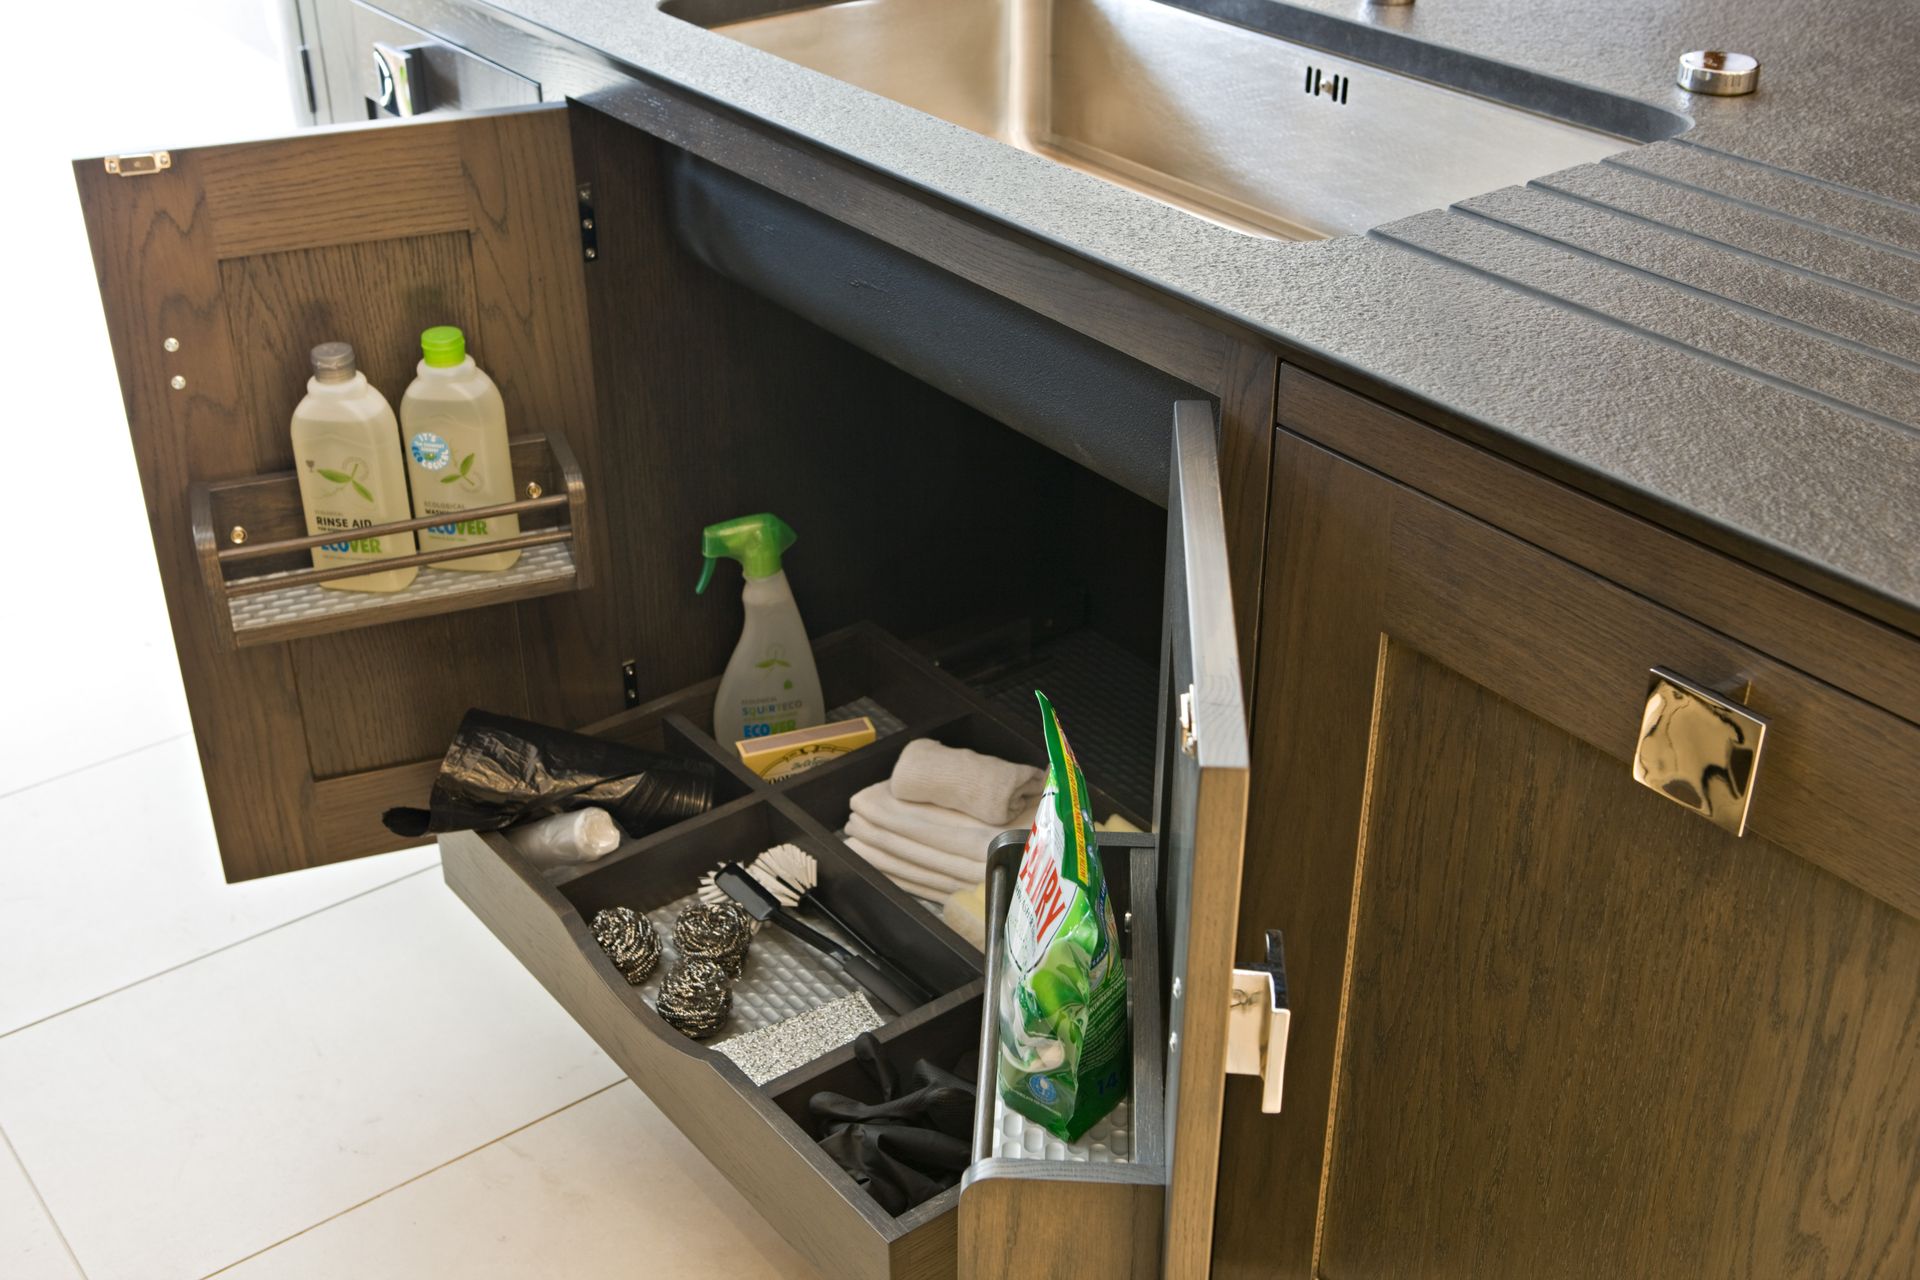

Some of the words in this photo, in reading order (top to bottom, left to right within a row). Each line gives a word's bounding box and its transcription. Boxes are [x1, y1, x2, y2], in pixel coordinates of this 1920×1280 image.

[316, 516, 349, 528] RINSE
[352, 519, 373, 528] AID
[743, 720, 796, 738] ECOVER
